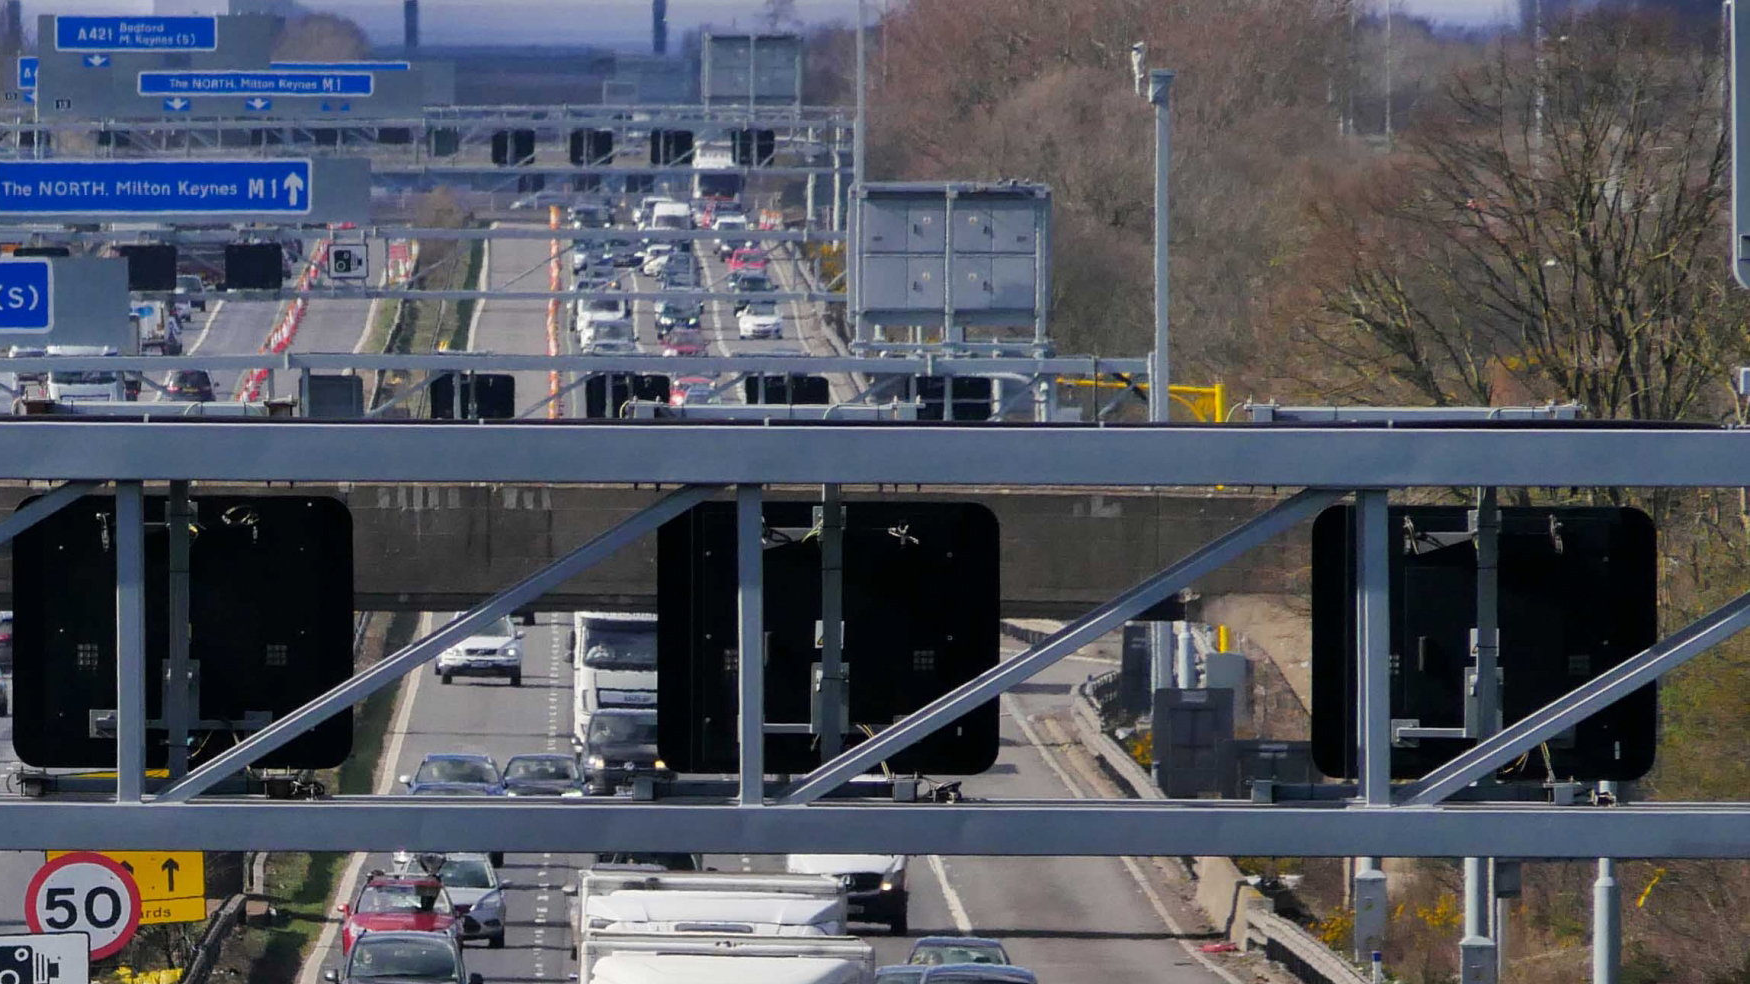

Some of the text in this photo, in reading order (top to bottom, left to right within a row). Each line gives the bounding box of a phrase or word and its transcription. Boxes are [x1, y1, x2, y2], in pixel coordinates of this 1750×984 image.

[78, 27, 112, 40] A421
[170, 79, 188, 88] The
[241, 77, 275, 89] Milton
[278, 78, 317, 90] Keynes
[2, 182, 32, 196] The
[116, 181, 170, 195] Milton
[178, 181, 237, 198] Keynes
[45, 886, 123, 930] 50
